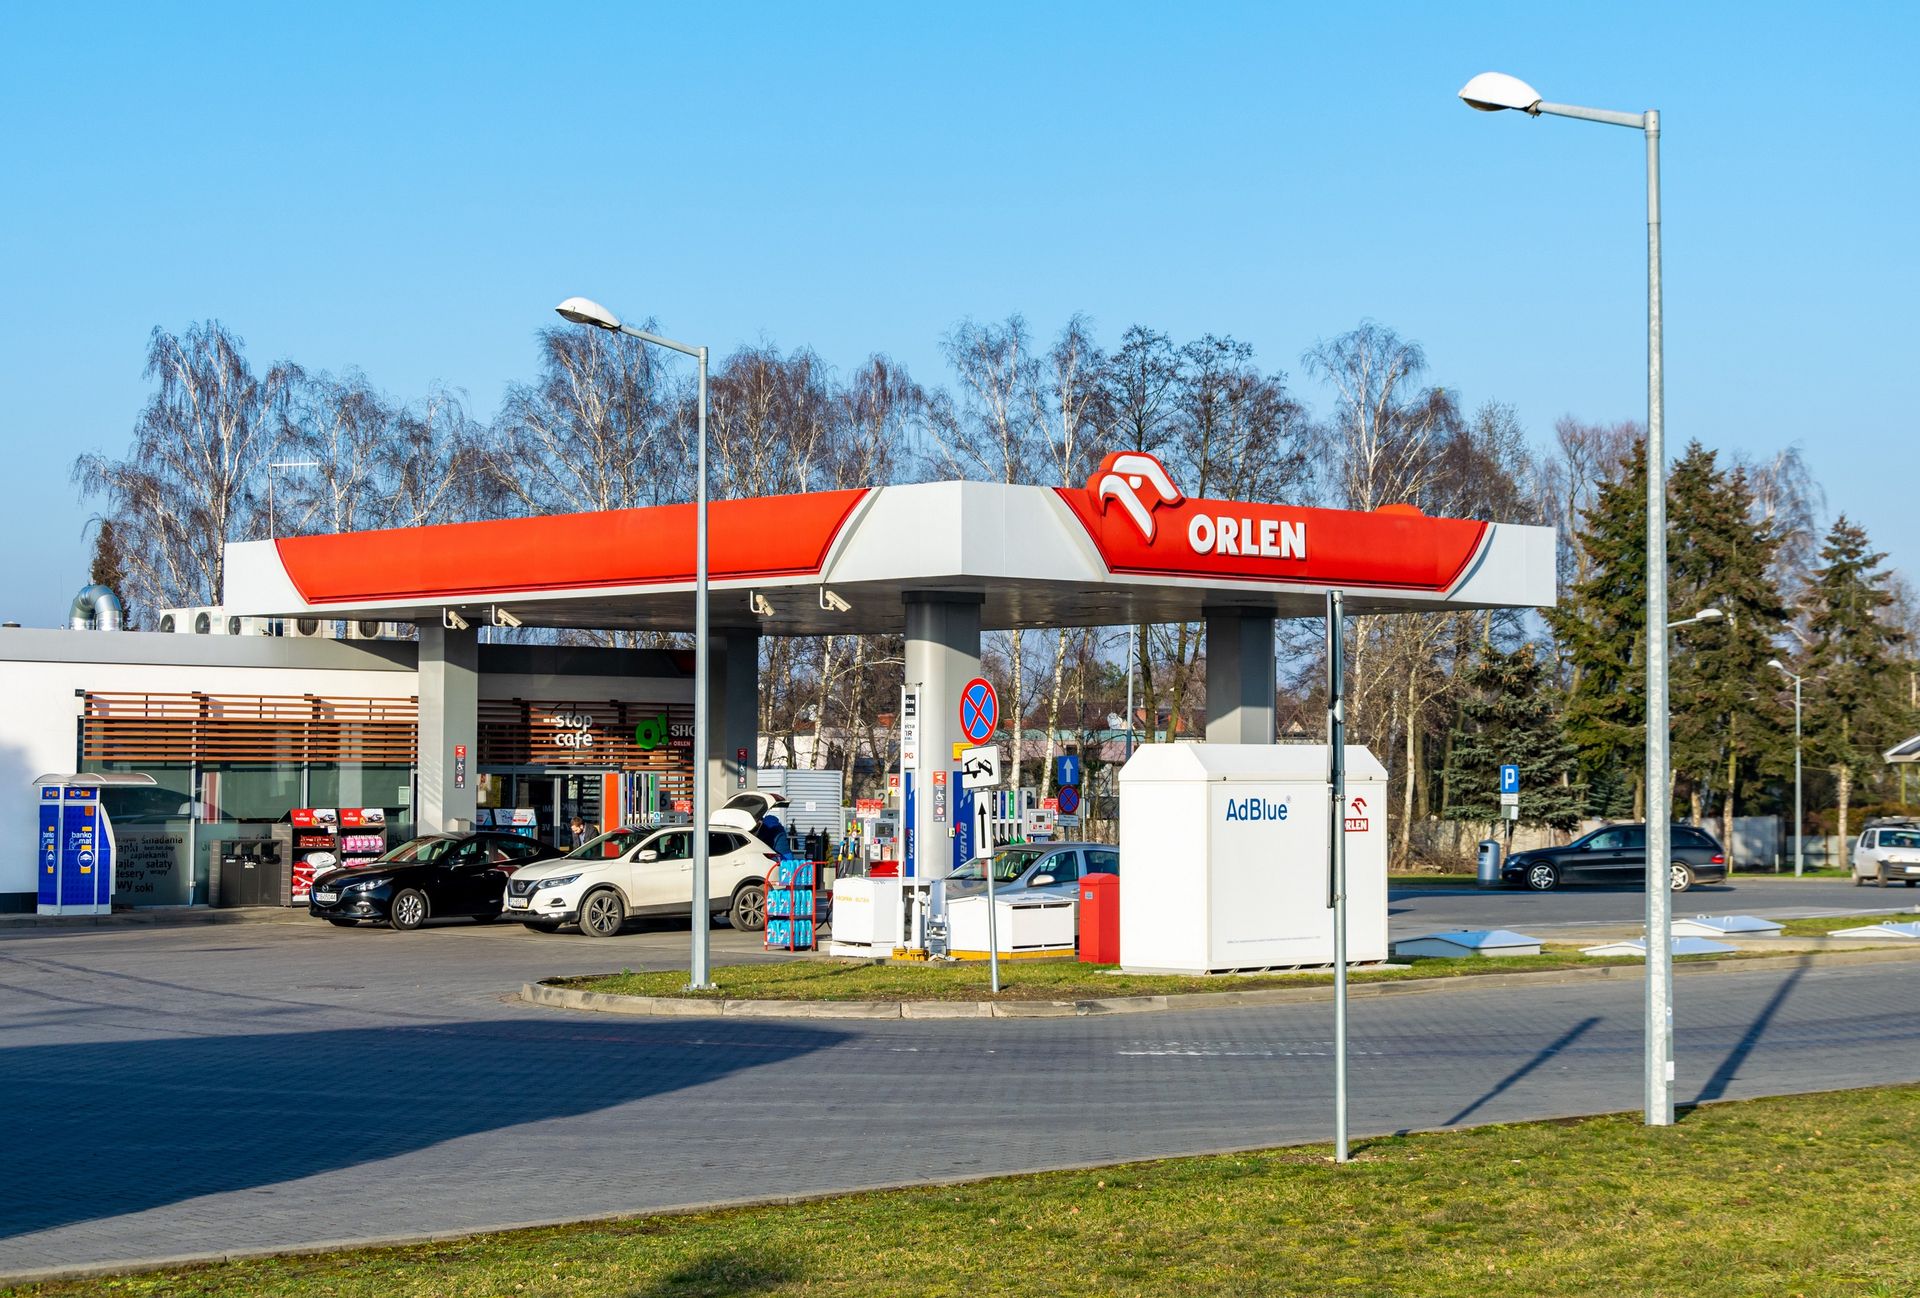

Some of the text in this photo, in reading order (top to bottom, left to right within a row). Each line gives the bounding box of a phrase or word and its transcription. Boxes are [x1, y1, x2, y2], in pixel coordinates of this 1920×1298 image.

[1188, 513, 1306, 560] ORLEN
[555, 712, 593, 732] stop
[671, 724, 695, 737] SHO
[555, 730, 593, 749] cafe
[1504, 768, 1515, 790] P
[1226, 798, 1288, 821] AdBlue
[1345, 819, 1367, 831] RLEN
[959, 822, 967, 862] verva
[130, 851, 168, 860] zapiekanki
[135, 883, 154, 893] soki
